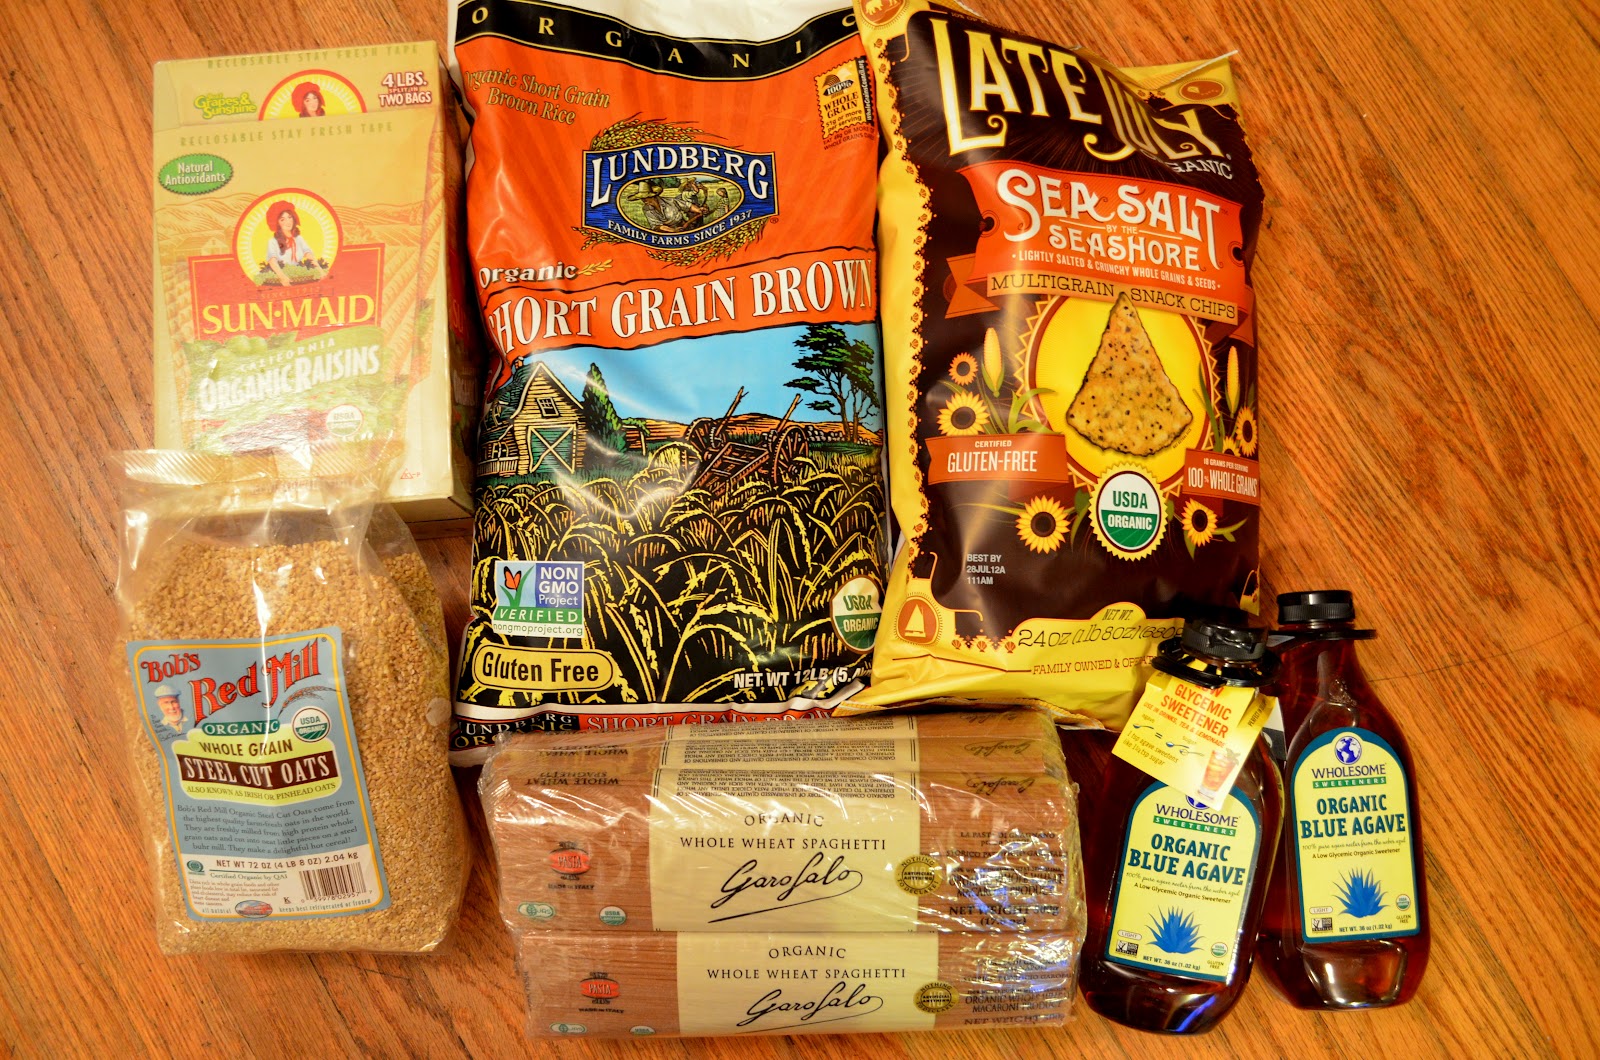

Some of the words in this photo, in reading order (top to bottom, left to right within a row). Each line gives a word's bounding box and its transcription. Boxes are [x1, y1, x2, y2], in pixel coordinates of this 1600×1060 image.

[207, 52, 295, 69] RECLOSABLE
[297, 50, 327, 63] STAY
[336, 48, 378, 60] FRESH
[387, 45, 418, 56] TAPE
[382, 72, 394, 87] 4
[396, 71, 428, 87] LBS.
[826, 80, 852, 95] 100%
[929, 18, 1102, 157] LATE
[466, 69, 517, 91] rganic
[520, 74, 560, 99] Short
[564, 86, 611, 108] Grain
[194, 95, 240, 109] Grapes
[240, 92, 251, 105] &
[378, 93, 404, 106] TWO
[405, 91, 432, 105] BAGS
[487, 87, 538, 115] Brown
[541, 101, 576, 124] Rice
[824, 92, 859, 111] WHOLE
[203, 104, 257, 119] Sunshine
[827, 100, 857, 118] GRAIN
[180, 131, 263, 147] RECLOSABLE
[272, 129, 301, 141] STAY
[311, 125, 352, 136] FRESH
[361, 122, 393, 133] TAPE
[178, 161, 213, 173] Natural
[165, 172, 226, 187] Antioxidants
[591, 146, 769, 208] LUNDBERG
[608, 220, 648, 241] FAMILY
[651, 234, 690, 246] FARMS
[694, 221, 726, 242] SINCE
[729, 209, 752, 227] 1937
[997, 169, 1115, 242] SEA
[1116, 184, 1221, 271] SALT
[1106, 224, 1117, 233] BY
[1121, 225, 1138, 235] THE
[1049, 223, 1200, 272] SEASHORE
[478, 262, 577, 288] Organic
[1018, 251, 1055, 263] LIGHTLY
[1056, 254, 1085, 268] SALTED
[1087, 259, 1094, 269] &
[1095, 261, 1130, 276] CRUNCHY
[1132, 267, 1159, 280] WHOLE
[1160, 271, 1186, 285] GRAINS
[1187, 275, 1194, 286] &
[1195, 277, 1216, 291] SEEDS
[611, 276, 736, 339] GRAIN
[753, 258, 873, 318] BROWN
[991, 274, 1114, 298] MULTIGRAIN
[1131, 287, 1185, 309] SNACK
[1189, 298, 1236, 320] CHIPS
[198, 368, 292, 412] ORGANIC
[294, 344, 381, 392] RAISINS
[974, 440, 1012, 448] CERTIFIED
[947, 450, 1038, 472] GLUTEN-FREE
[1210, 469, 1236, 493] WHOLE
[1235, 474, 1258, 498] GRAINS
[1112, 490, 1148, 510] USDA
[1107, 513, 1153, 531] ORGANIC
[967, 554, 988, 563] BEST
[990, 554, 1001, 563] BY
[540, 567, 579, 580] NON
[966, 565, 1006, 574] 28JUL12A
[538, 581, 579, 594] GMO
[967, 576, 994, 585] 111AM
[538, 594, 579, 607] Project
[842, 594, 874, 612] USDA
[499, 608, 578, 623] VERIFIED
[1101, 608, 1118, 621] NET
[1118, 608, 1134, 621] WT.
[493, 623, 583, 636] nongmoproject.org
[843, 617, 878, 634] ORGANIC
[482, 651, 543, 683] Gluten
[550, 658, 599, 683] Free
[1033, 662, 1072, 675] FAMILY
[1074, 659, 1112, 672] OWNED
[1114, 658, 1120, 669] &
[140, 652, 201, 684] Bob's
[188, 663, 262, 728] Red
[261, 637, 322, 708] Mill
[733, 672, 763, 689] NET
[766, 671, 790, 687] WT
[794, 667, 830, 685] 12LB
[1174, 683, 1232, 721] GLYCEMIC
[300, 716, 321, 726] USDA
[1160, 695, 1229, 738] SWEETENER
[204, 720, 279, 735] ORGANIC
[299, 725, 326, 734] ORGANIC
[198, 742, 243, 757] WHOLE
[249, 739, 293, 757] GRAIN
[184, 756, 237, 783] STEEL
[240, 763, 273, 788] CUT
[280, 754, 330, 785] OATS
[1311, 764, 1386, 779] WHOLESOME
[186, 785, 206, 794] ALSO
[206, 786, 233, 796] KNOWN
[244, 790, 262, 799] IRISH
[264, 793, 275, 801] OR
[276, 788, 314, 801] PINHEAD
[314, 782, 336, 793] OATS
[1314, 777, 1386, 788] SWEETENERS
[177, 805, 196, 813] Bob's
[197, 805, 212, 813] Red
[213, 806, 228, 814] Mill
[228, 808, 256, 818] Organic
[257, 811, 275, 819] Steel
[276, 811, 291, 819] Cut
[293, 808, 312, 817] Oats
[313, 803, 334, 813] come
[335, 799, 355, 808] from
[1316, 794, 1387, 815] ORGANIC
[744, 812, 824, 827] ORGANIC
[1155, 803, 1239, 828] WHOLESOME
[1155, 815, 1236, 836] SWEETENERS
[1299, 817, 1347, 839] BLUE
[1352, 813, 1406, 836] AGAVE
[680, 837, 735, 849] WHOLE
[742, 837, 796, 849] WHEAT
[802, 838, 886, 850] SPAGHETTI
[1150, 833, 1231, 861] ORGANIC
[216, 859, 230, 867] NET
[233, 860, 245, 868] WT
[248, 861, 259, 869] 72
[274, 861, 284, 870] (4
[285, 860, 297, 868] LB
[324, 853, 345, 863] 2.04
[347, 852, 359, 860] kg
[1128, 848, 1179, 876] BLUE
[1182, 860, 1246, 886] AGAVE
[708, 852, 863, 912] Garofalo
[1121, 931, 1138, 939] LIGHT
[769, 946, 846, 959] ORGANIC
[707, 968, 760, 979] WHOLE
[766, 968, 818, 979] WHEAT
[825, 968, 906, 979] SPAGHETTI
[588, 983, 611, 995] PASTA
[735, 981, 883, 1030] Garofalo
